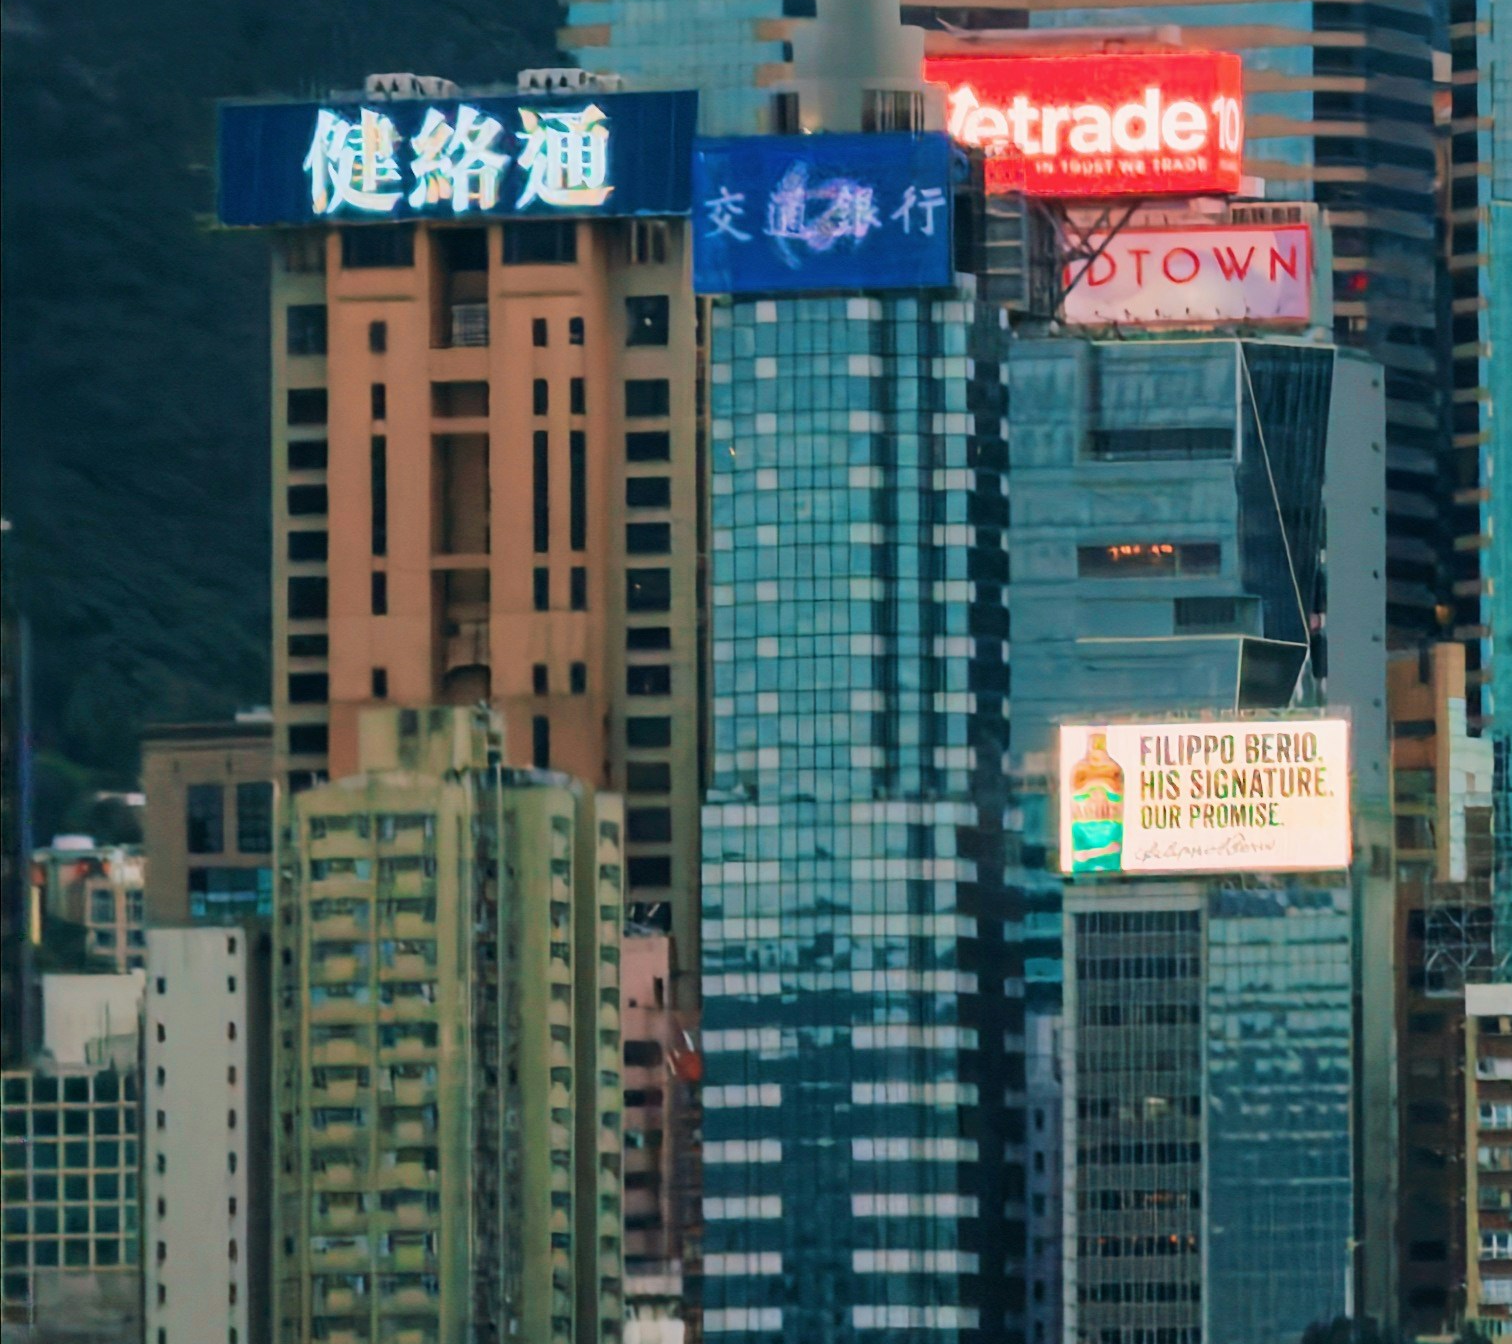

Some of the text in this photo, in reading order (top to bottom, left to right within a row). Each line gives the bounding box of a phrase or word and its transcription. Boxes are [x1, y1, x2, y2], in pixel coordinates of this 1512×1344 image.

[303, 104, 616, 214] 健絡通
[1139, 732, 1324, 766] FILIPPO BERIO.
[1139, 766, 1335, 801] HIS SIGNATURE.
[1140, 801, 1285, 830] OUR PROMISE.
